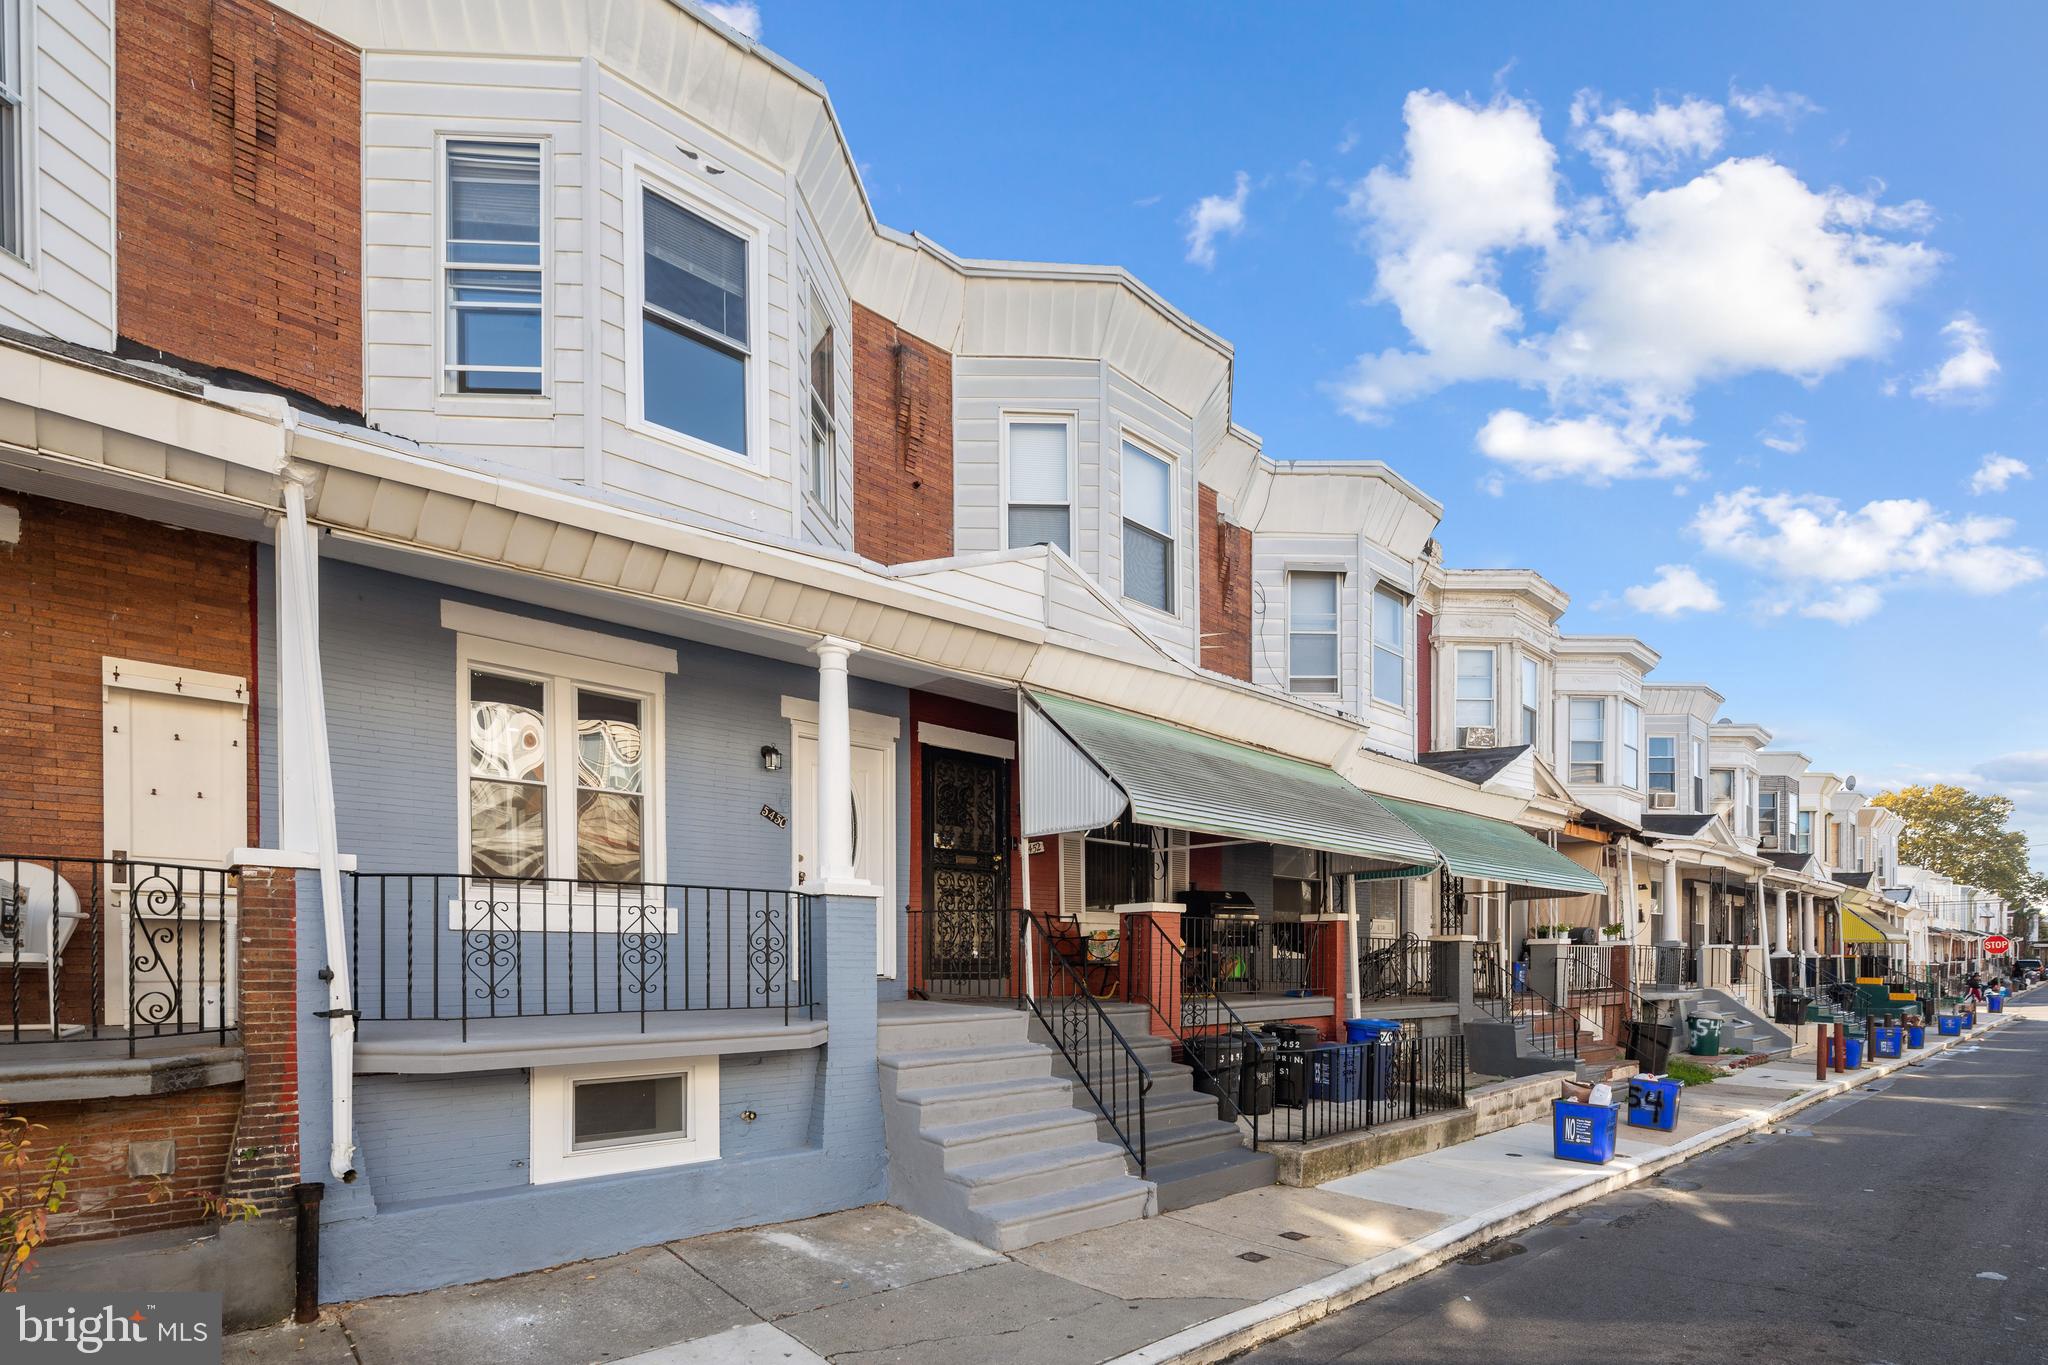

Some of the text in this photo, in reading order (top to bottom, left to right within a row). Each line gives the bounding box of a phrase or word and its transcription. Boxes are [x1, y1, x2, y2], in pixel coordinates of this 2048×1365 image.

[1985, 941, 2008, 949] STOP
[1629, 1085, 1662, 1124] 54
[1565, 1117, 1576, 1140] NO
